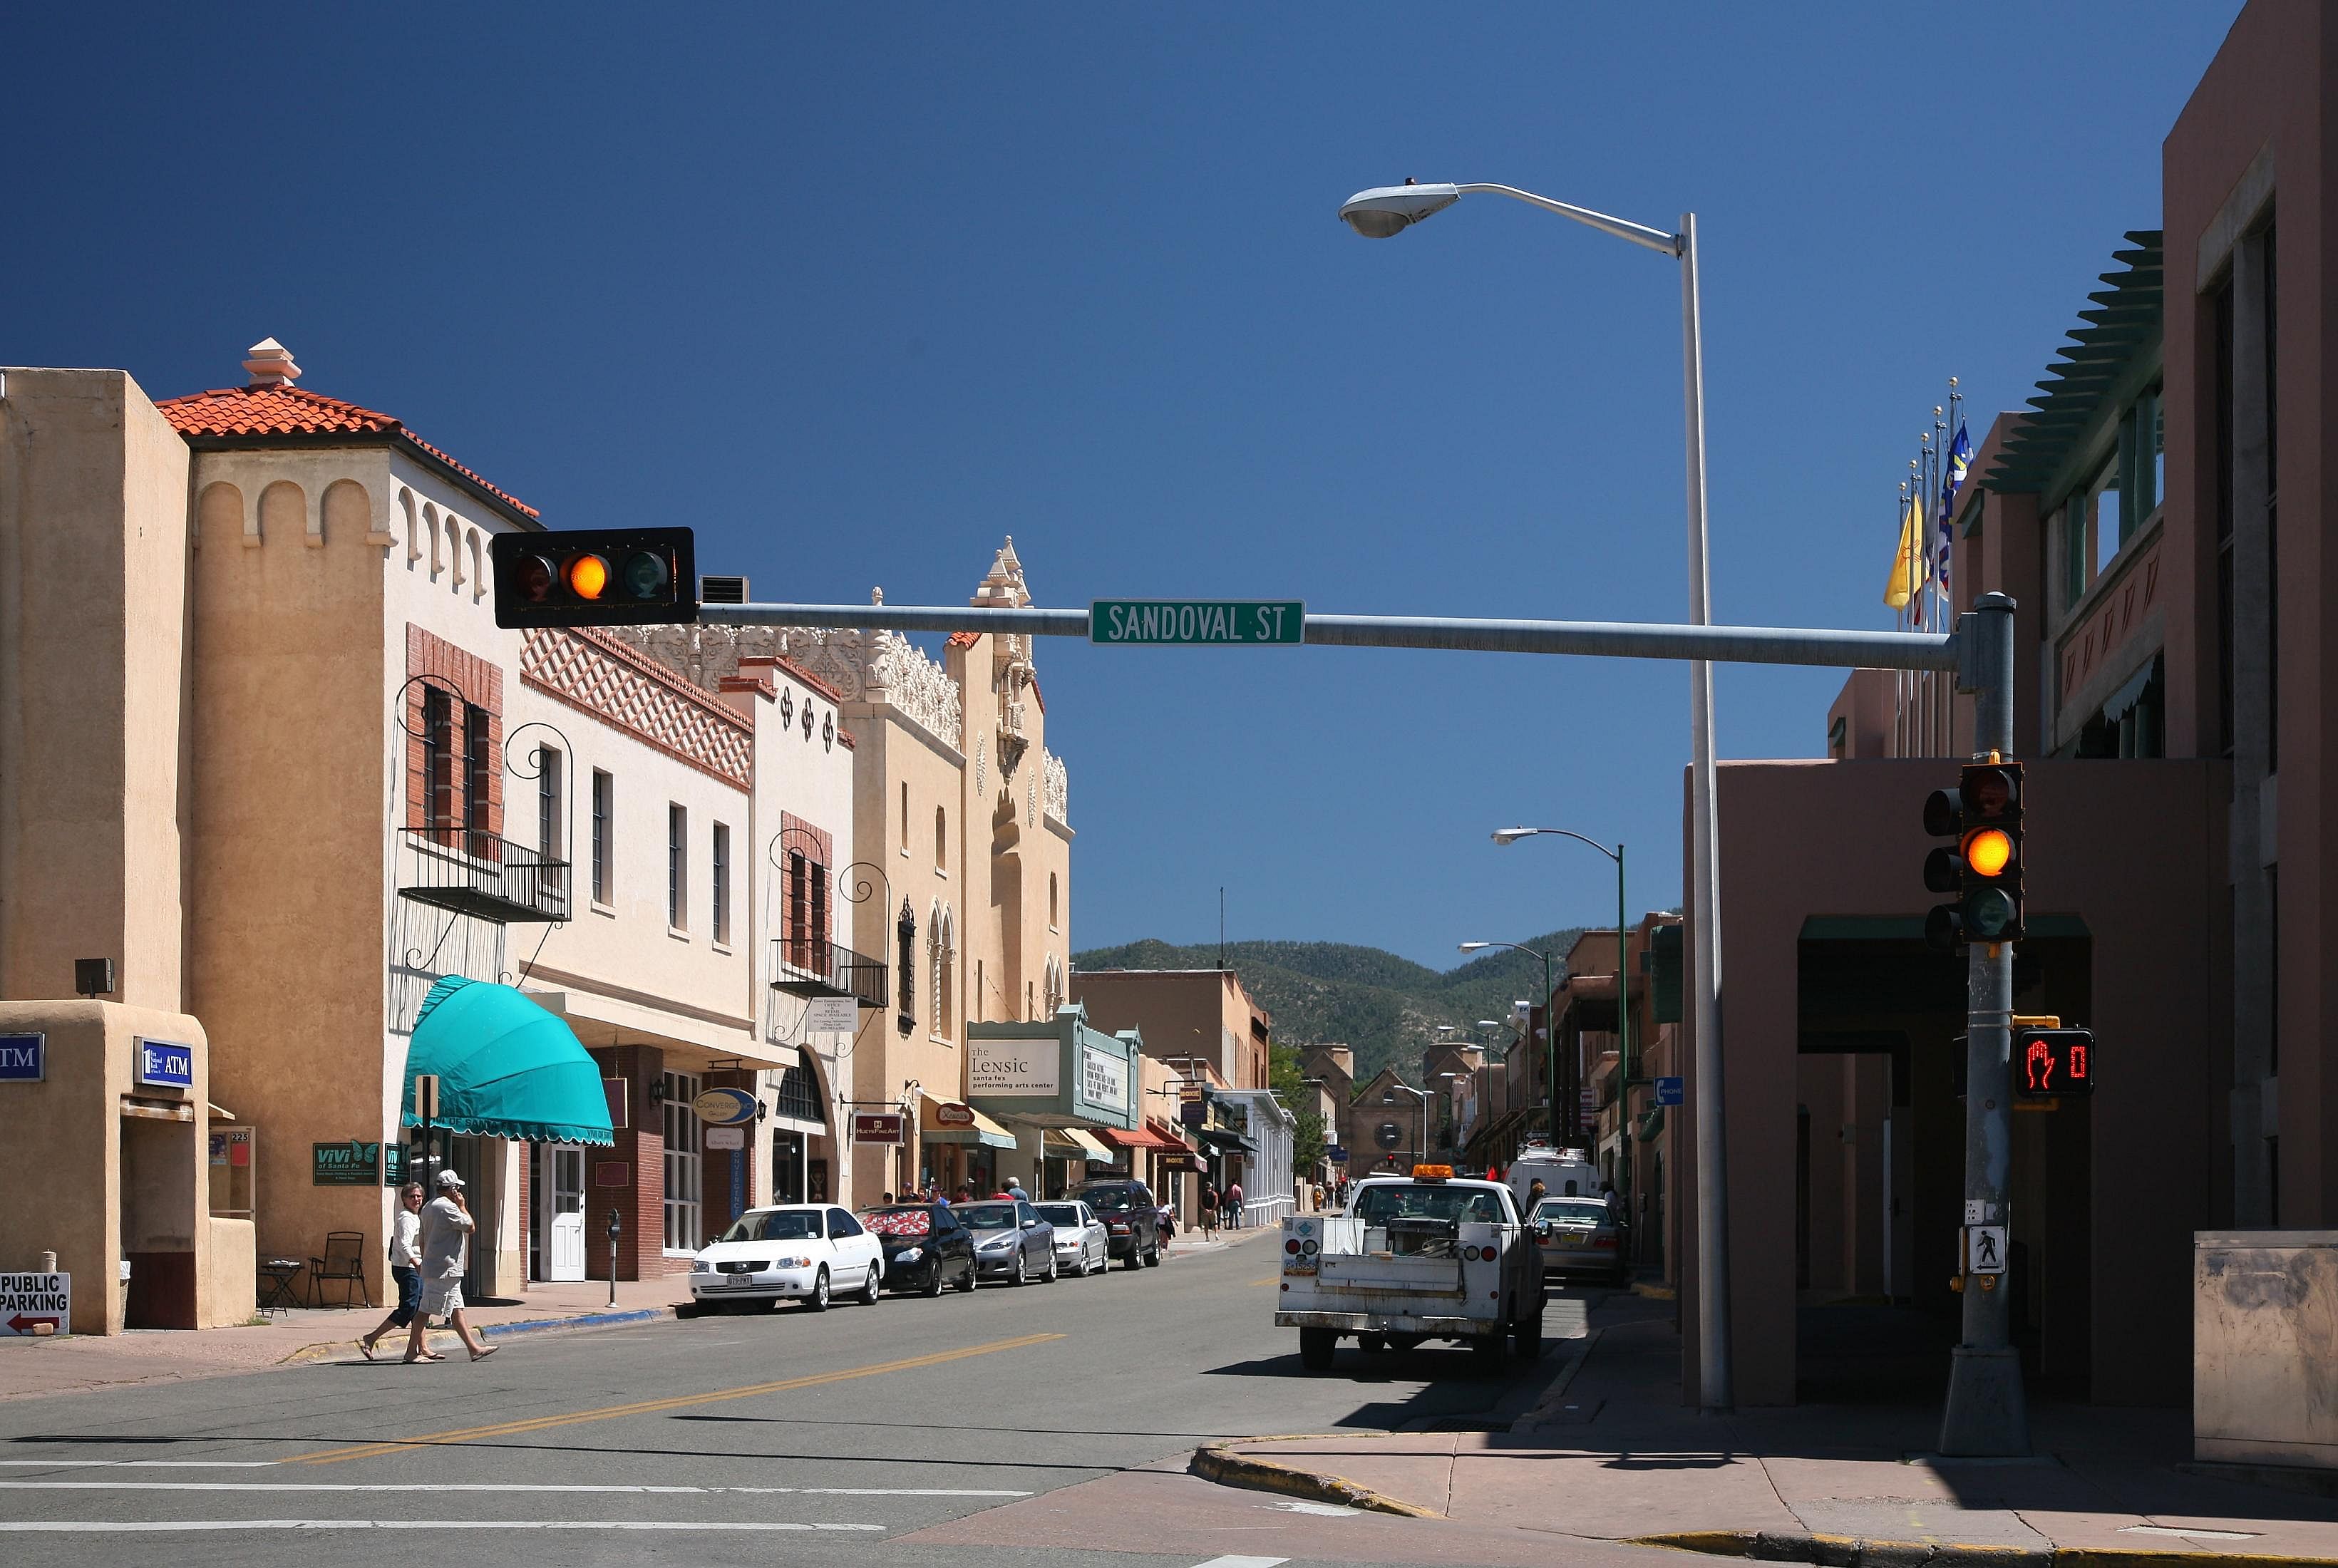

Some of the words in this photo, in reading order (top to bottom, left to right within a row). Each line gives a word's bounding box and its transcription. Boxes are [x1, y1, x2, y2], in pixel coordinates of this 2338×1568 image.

[1108, 606, 1242, 640] SANDOVAL
[1256, 606, 1285, 640] ST
[0, 1048, 34, 1067] TM
[972, 1047, 989, 1056] The
[165, 1056, 187, 1076] ATM
[972, 1058, 1028, 1073] Lensic
[465, 1118, 497, 1130] SANTA
[318, 1149, 351, 1163] ViVi
[1, 1275, 59, 1293] PUBLIC
[0, 1294, 67, 1311] PARKING
